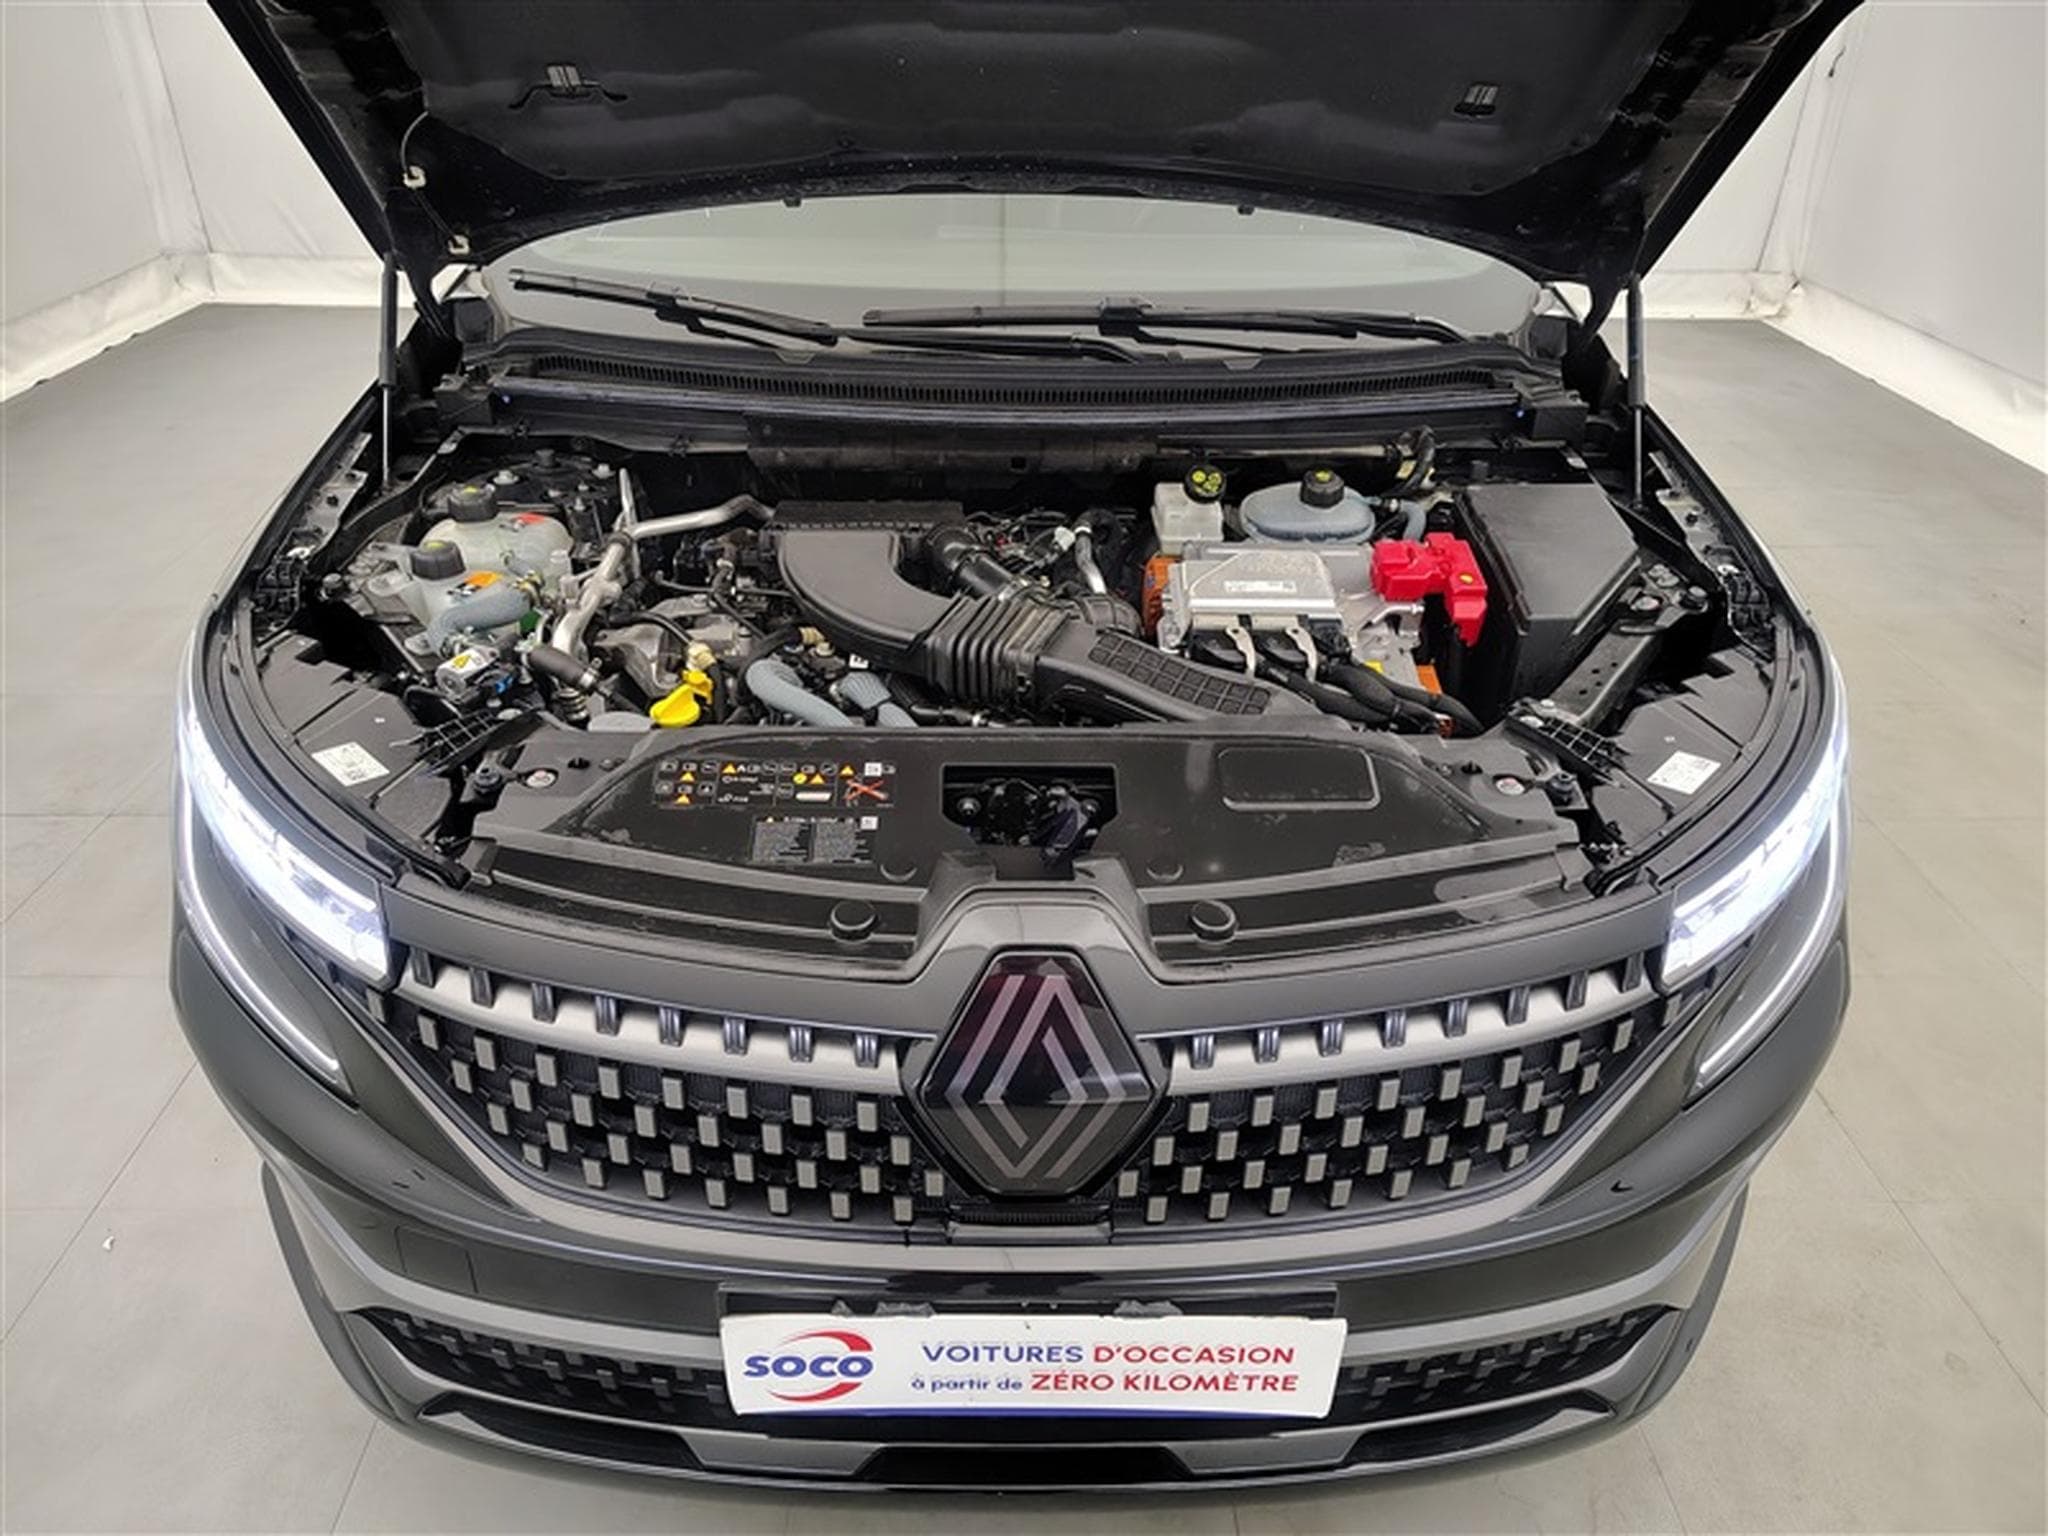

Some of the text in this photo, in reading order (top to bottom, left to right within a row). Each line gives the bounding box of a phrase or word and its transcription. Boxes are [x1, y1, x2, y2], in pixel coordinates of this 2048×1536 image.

[922, 1345, 1294, 1364] VOITURES D'OCCASION
[743, 1355, 874, 1378] SOCO
[931, 1378, 991, 1393] partir
[997, 1377, 1023, 1391] de
[1031, 1370, 1115, 1391] ZÉRO
[1124, 1372, 1299, 1392] KILOMÈTRE
